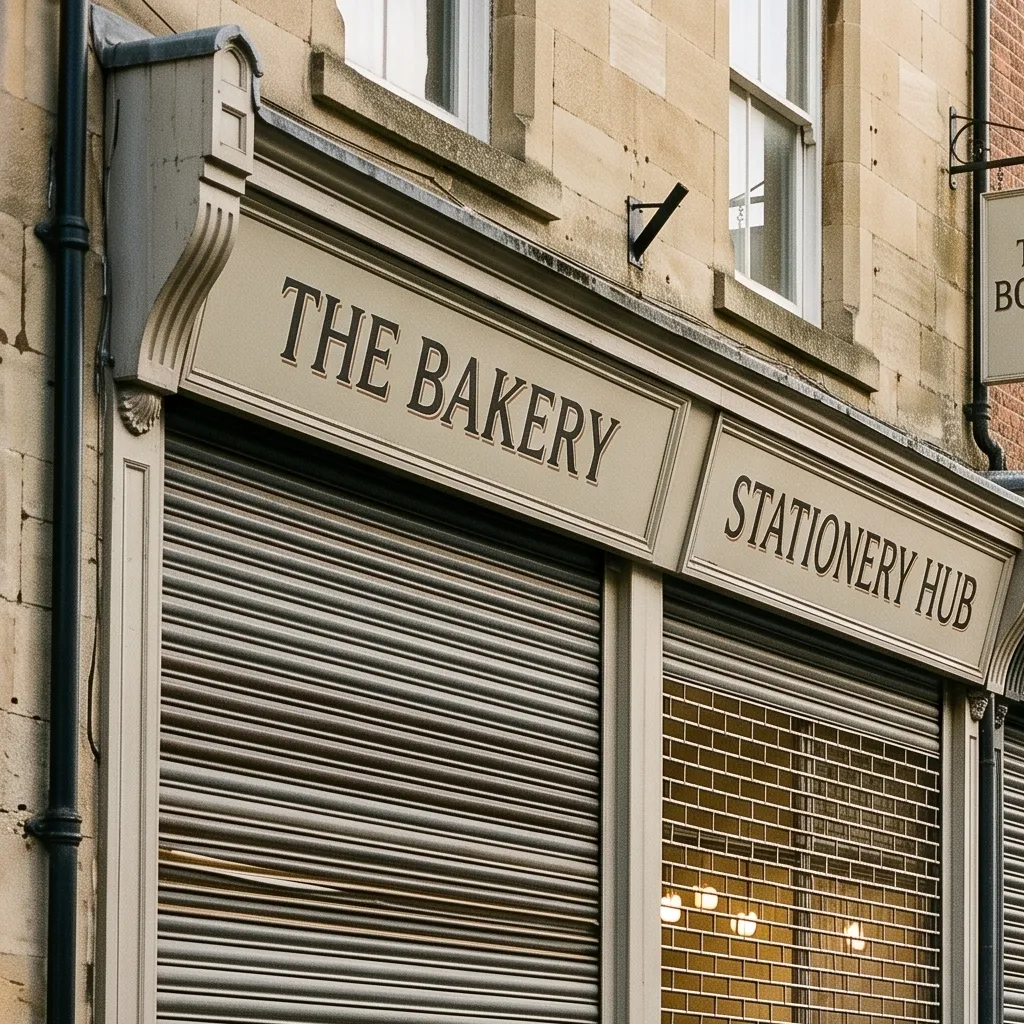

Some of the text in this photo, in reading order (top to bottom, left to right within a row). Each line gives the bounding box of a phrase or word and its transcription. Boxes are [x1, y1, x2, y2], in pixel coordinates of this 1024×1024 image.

[280, 276, 621, 487] THE BAKERY
[724, 475, 978, 633] STATIONERY HUB
